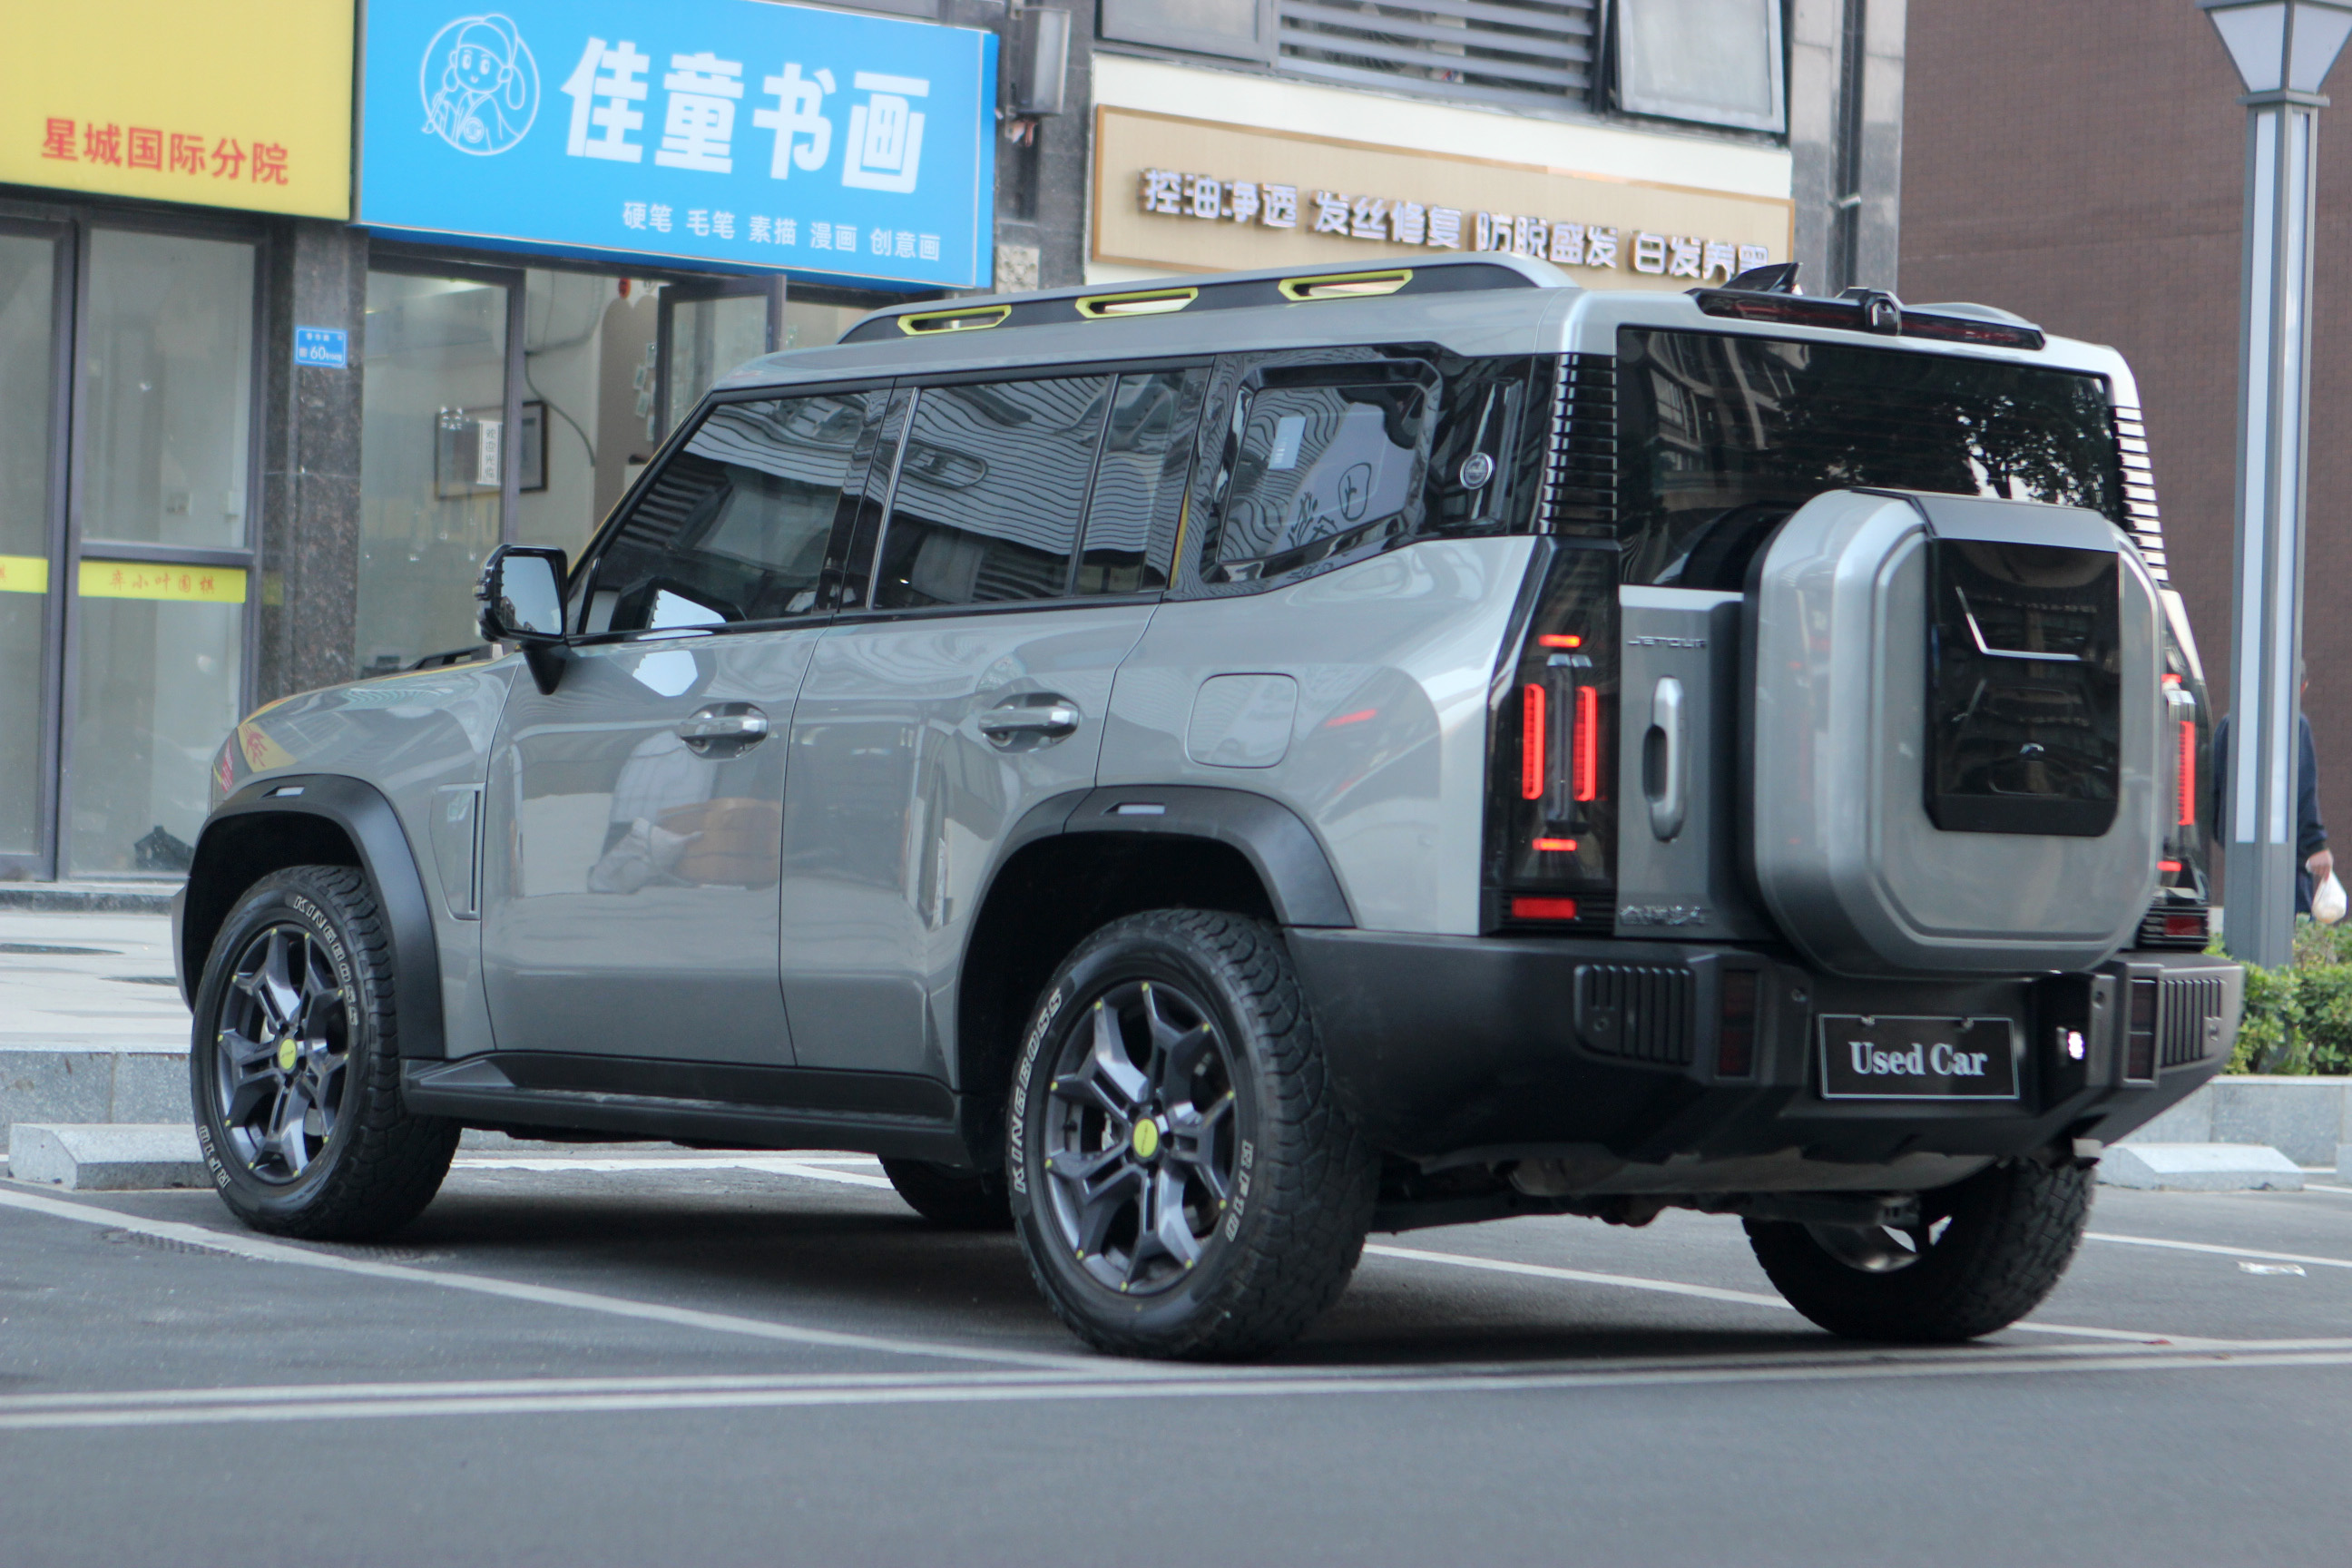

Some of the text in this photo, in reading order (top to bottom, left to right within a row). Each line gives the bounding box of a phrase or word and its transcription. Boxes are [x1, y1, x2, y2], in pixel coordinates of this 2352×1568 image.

[41, 116, 289, 186] 星城国际分院
[560, 35, 930, 194] 佳童书画
[622, 201, 942, 262] 硬笔 毛笔 素描 漫画 创意画
[1142, 167, 1298, 229] 控油净透
[1313, 190, 1463, 250] 发丝修复
[1474, 210, 1618, 269] 防脱盛发
[485, 427, 496, 481] 欢迎光临
[293, 895, 358, 1027] KINGBOSS
[1011, 987, 1063, 1194] KINGBOSS
[1847, 1041, 1989, 1076] Used Car
